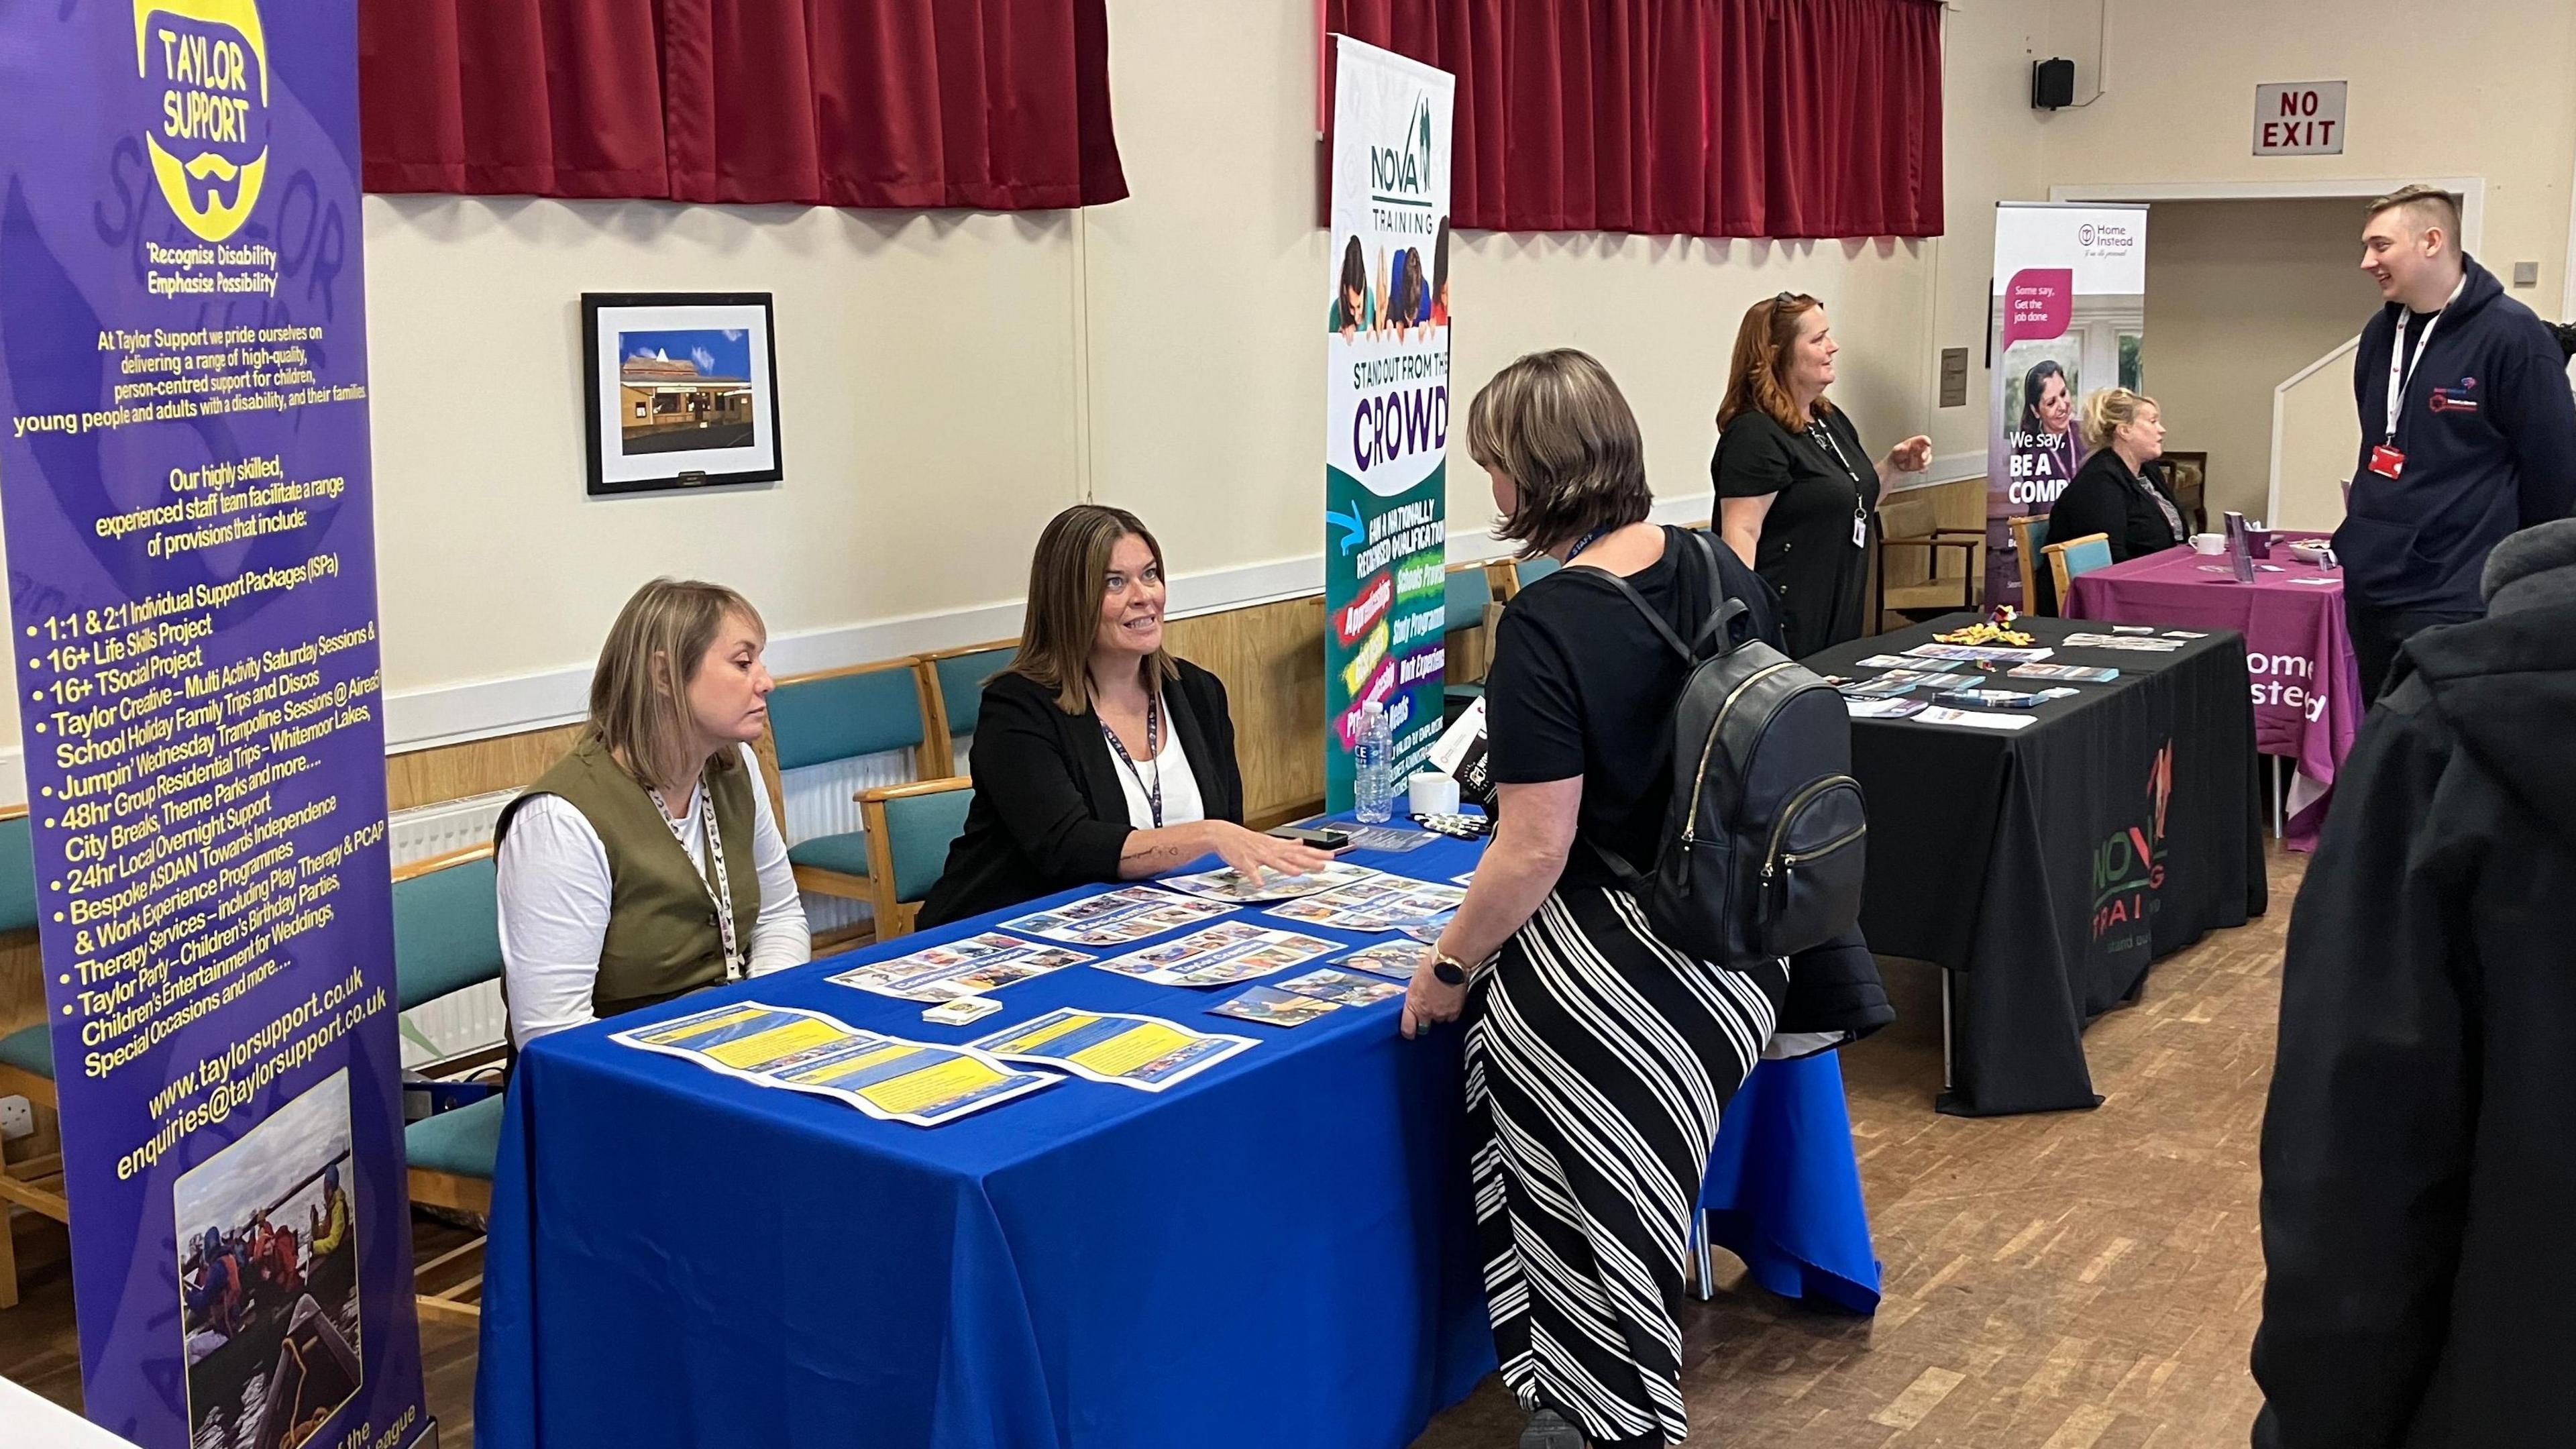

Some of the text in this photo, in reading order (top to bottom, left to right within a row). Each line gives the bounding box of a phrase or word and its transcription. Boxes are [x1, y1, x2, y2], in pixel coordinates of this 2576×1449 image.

[158, 29, 246, 91] TAYLOR
[164, 91, 249, 143] SUPPORT
[2280, 91, 2318, 117] NO
[1372, 115, 1420, 195] NOVA
[2263, 121, 2336, 147] EXIT
[1373, 209, 1432, 235] TRAINING
[2097, 225, 2126, 235] Home
[2097, 236, 2133, 246] Instead
[148, 271, 214, 299] Emphasise
[218, 244, 276, 275] Disability
[2014, 299, 2042, 309] Get the
[2015, 286, 2037, 295] Some
[97, 323, 323, 354] At Taylor Support we pride ourselves on
[2013, 312, 2048, 324] job done
[113, 366, 316, 405] person-centred support for children,
[121, 352, 181, 375] delivering
[195, 354, 226, 372] range
[227, 347, 238, 367] of
[1401, 354, 1432, 382] FROM
[13, 413, 77, 437] young
[81, 405, 131, 433] people
[131, 401, 154, 423] and
[155, 398, 198, 419] adults
[199, 395, 223, 415] with
[231, 390, 286, 411] disability,
[288, 388, 306, 407] and
[307, 386, 331, 404] their
[1353, 385, 1447, 472] CROWD
[2009, 431, 2065, 451] We say,
[2010, 454, 2052, 477] BE A
[169, 453, 283, 492] Our highly skilled,
[95, 476, 344, 540] experienced staff team facilitate range
[147, 506, 307, 559] of provisions that include:
[44, 612, 78, 641] 1:1
[85, 609, 103, 635] &
[103, 602, 127, 631] 2:1
[129, 586, 194, 625] Individual
[195, 574, 246, 609] Support
[245, 565, 307, 594] Packages
[46, 612, 213, 673] 16+ Life Skills Project
[49, 677, 93, 704] 16+
[150, 644, 203, 680] Project
[50, 620, 375, 739] Taylor Creative Multi Activity Saturday Sessions &
[56, 669, 319, 768] School Holiday Family Trips and Discos
[57, 681, 347, 800] Jumpin' Wednesday Trampoline Sessions @
[60, 800, 112, 830] 48hr
[114, 785, 156, 816] Group
[156, 750, 233, 798] Residential
[233, 743, 261, 769] Trips
[334, 704, 370, 729] Lakes,
[64, 833, 108, 861] City
[110, 812, 160, 850] Breaks,
[160, 793, 213, 825] Theme
[214, 776, 248, 806] Parks
[248, 762, 270, 791] and
[66, 790, 272, 894] 24hr Local Overnight Support
[69, 795, 336, 925] Bespoke ASDAN Towards Independence
[73, 819, 384, 985] Therapy Services including Play Therapy & PCAP
[74, 841, 294, 955] & Work Experience Programmes
[76, 978, 138, 1016] Taylor
[138, 957, 169, 992] Party
[180, 917, 248, 965] Children's
[248, 892, 297, 932] Birthday
[81, 991, 162, 1046] Children's
[162, 939, 256, 1006] Entertainment
[254, 933, 271, 956] for
[84, 1026, 149, 1079] Special
[150, 992, 220, 1044] Occasions
[221, 971, 246, 1004] and
[367, 1404, 416, 1449] eague
